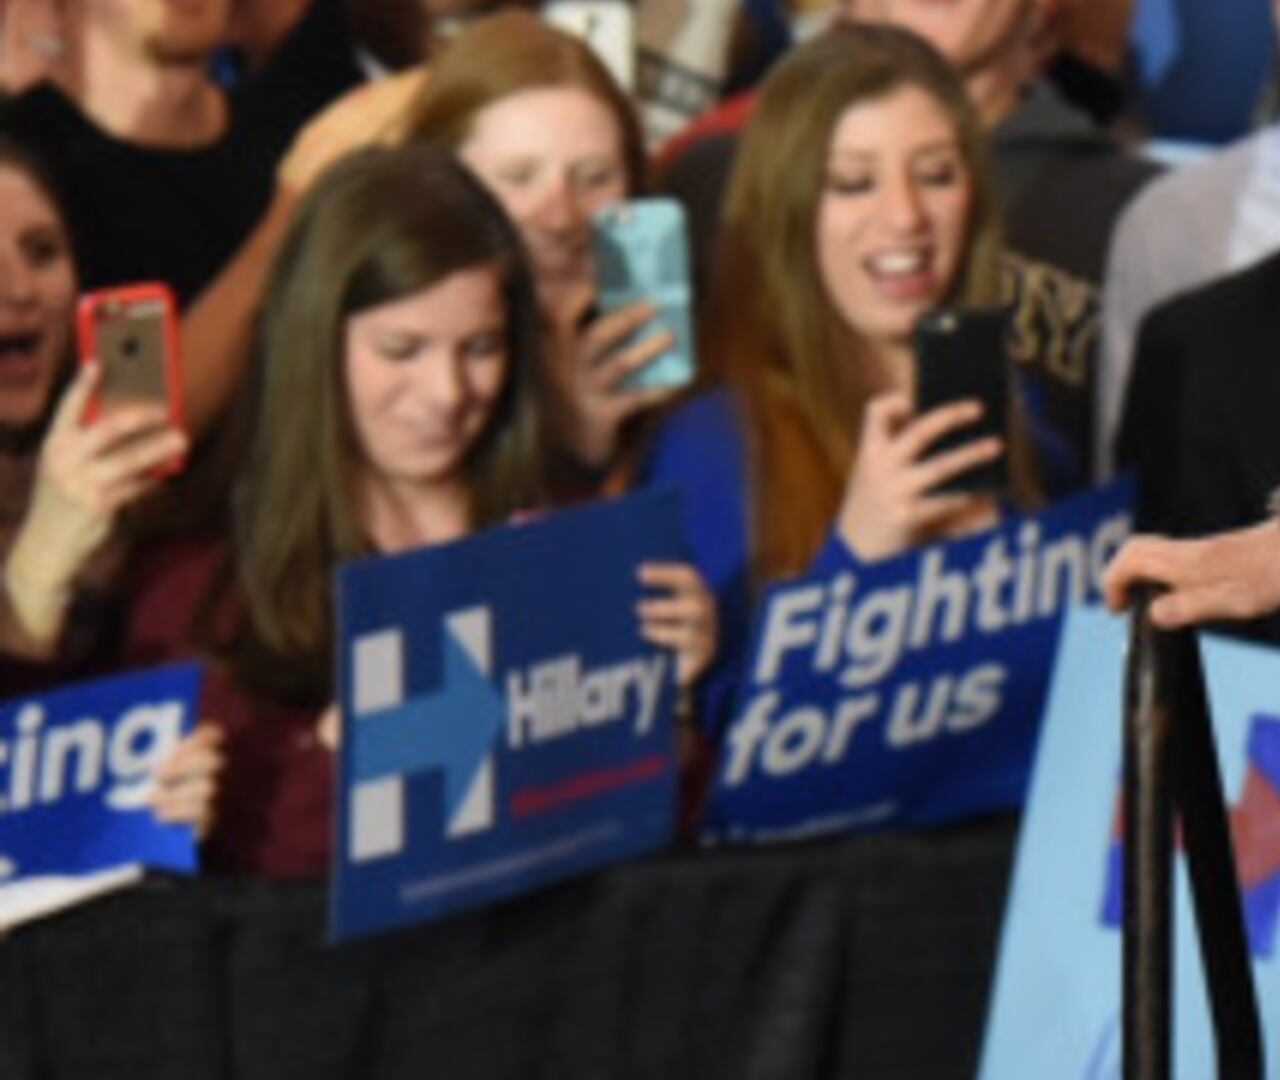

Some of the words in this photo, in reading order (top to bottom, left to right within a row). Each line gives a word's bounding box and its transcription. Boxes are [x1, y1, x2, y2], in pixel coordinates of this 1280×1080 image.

[0, 701, 184, 811] ing
[507, 652, 667, 750] Hillary
[722, 686, 879, 786] for
[885, 663, 1007, 749] us
